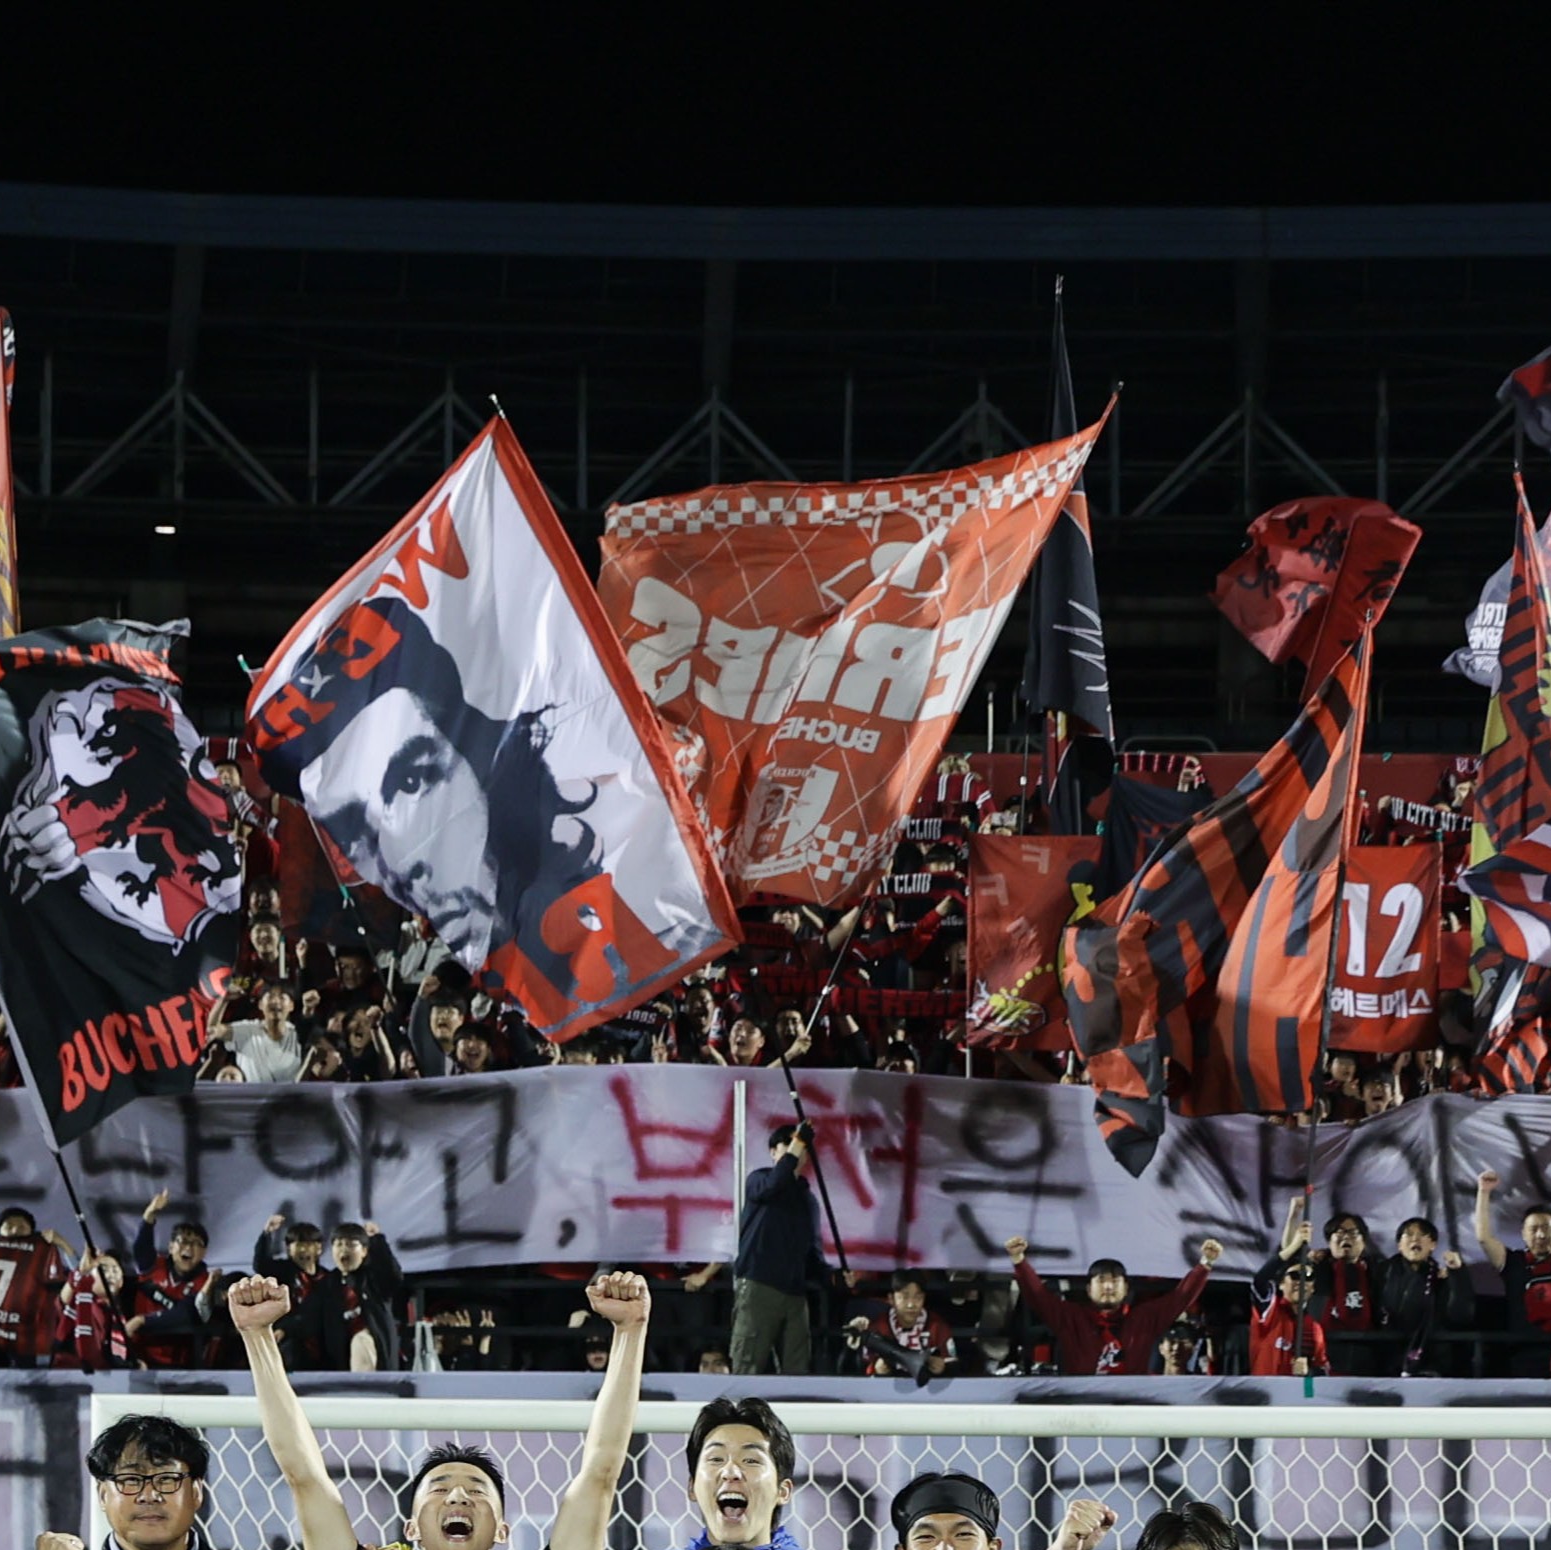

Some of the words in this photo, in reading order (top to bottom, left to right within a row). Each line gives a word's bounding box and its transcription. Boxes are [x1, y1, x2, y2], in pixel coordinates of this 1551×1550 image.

[905, 817, 942, 839] CLUB
[894, 873, 932, 894] CLUB
[1342, 882, 1425, 979] 12
[1330, 985, 1434, 1020] 헤르메스
